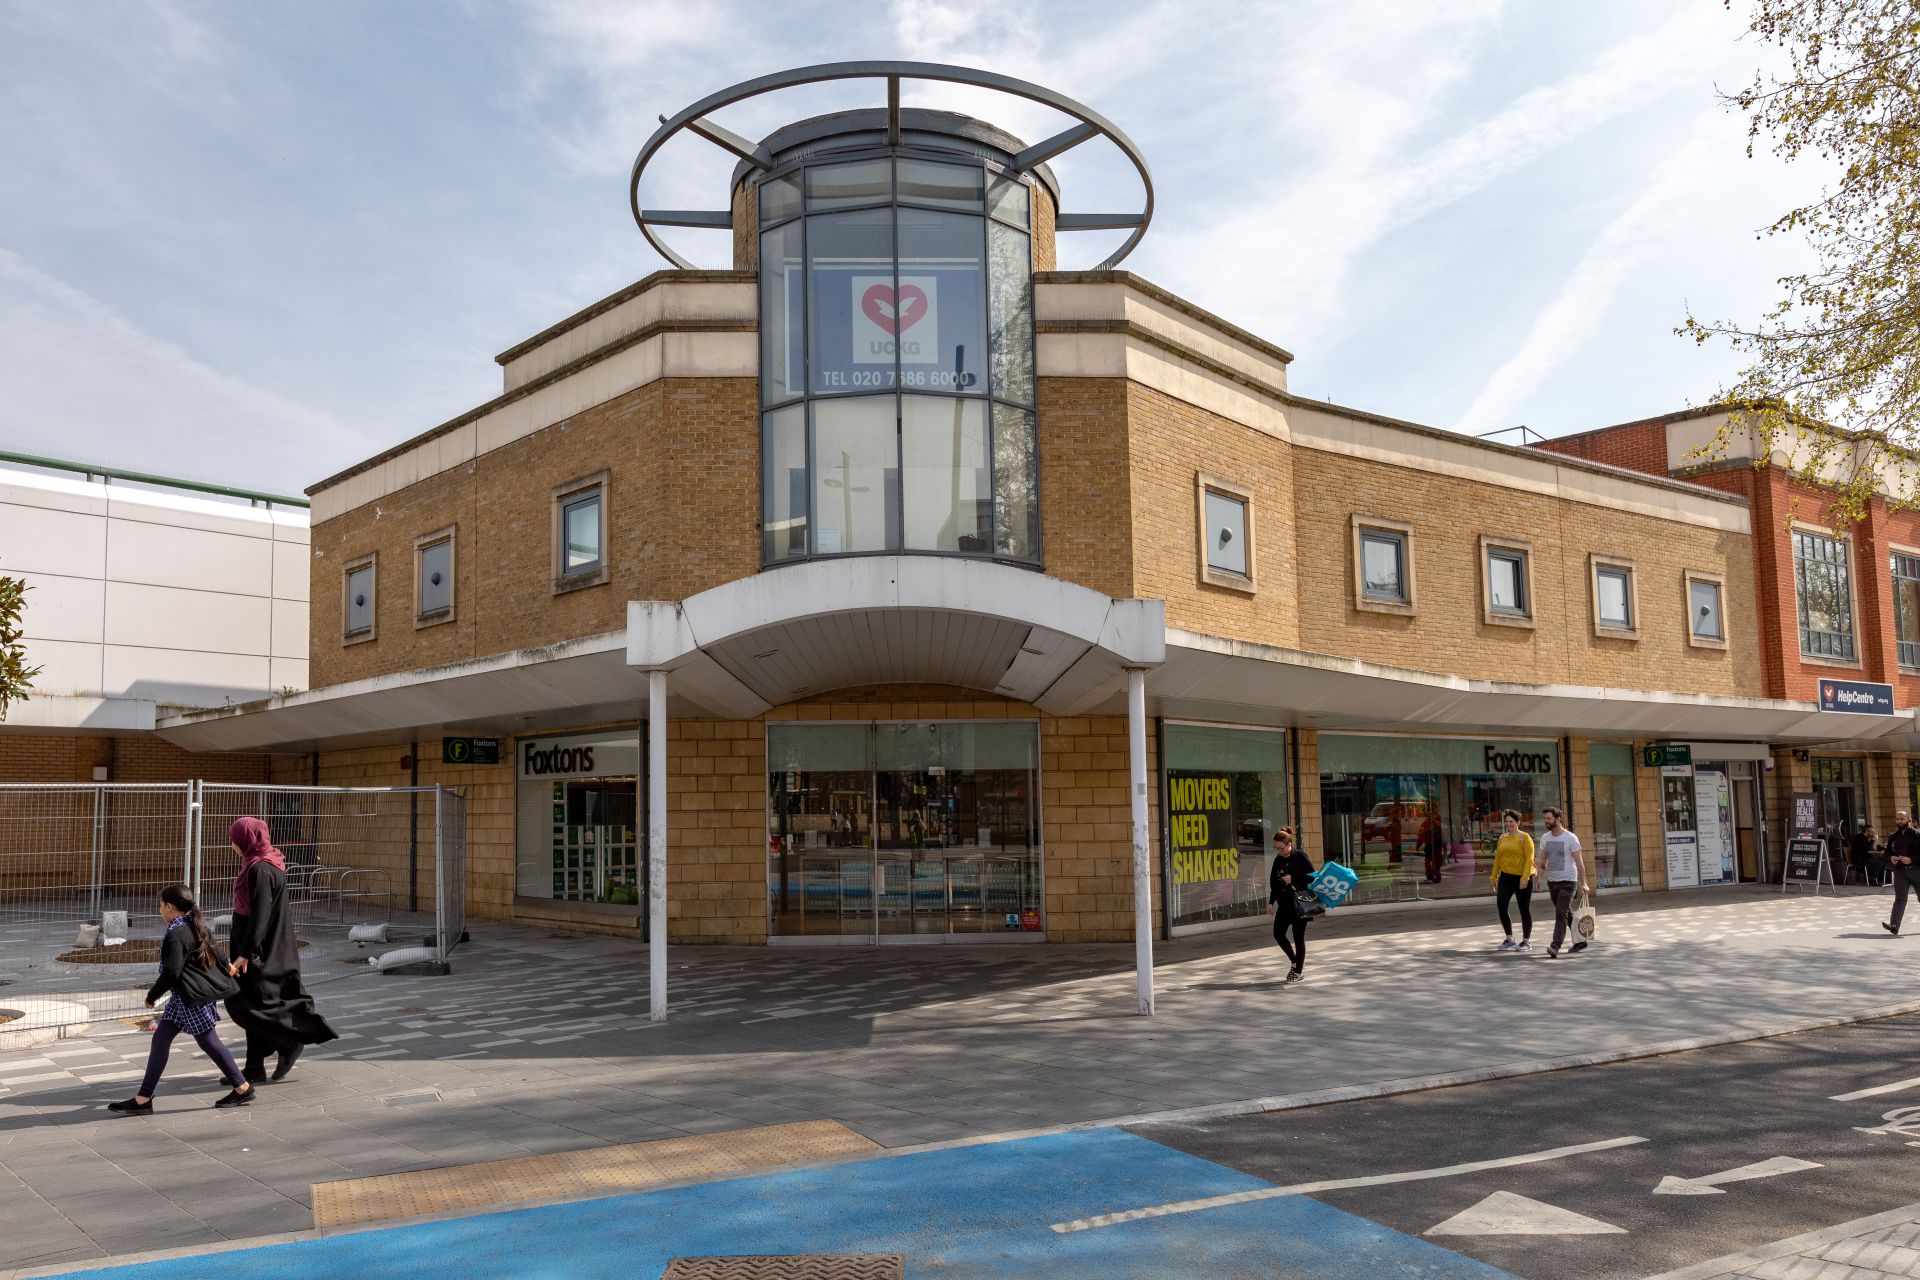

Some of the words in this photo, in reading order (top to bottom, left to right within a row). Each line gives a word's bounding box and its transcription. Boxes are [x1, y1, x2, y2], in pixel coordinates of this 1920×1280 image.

[823, 371, 848, 386] TEL
[852, 371, 882, 386] 020
[930, 371, 969, 386] 6000
[1838, 690, 1874, 705] HelpCentre
[473, 739, 497, 747] Foxtons
[524, 742, 594, 775] Foxtons
[1485, 746, 1551, 773] Foxtons
[1170, 777, 1231, 811] MOVERS
[1796, 806, 1814, 815] REALLY
[1171, 814, 1209, 848] NEED
[1173, 848, 1239, 885] SHAKERS
